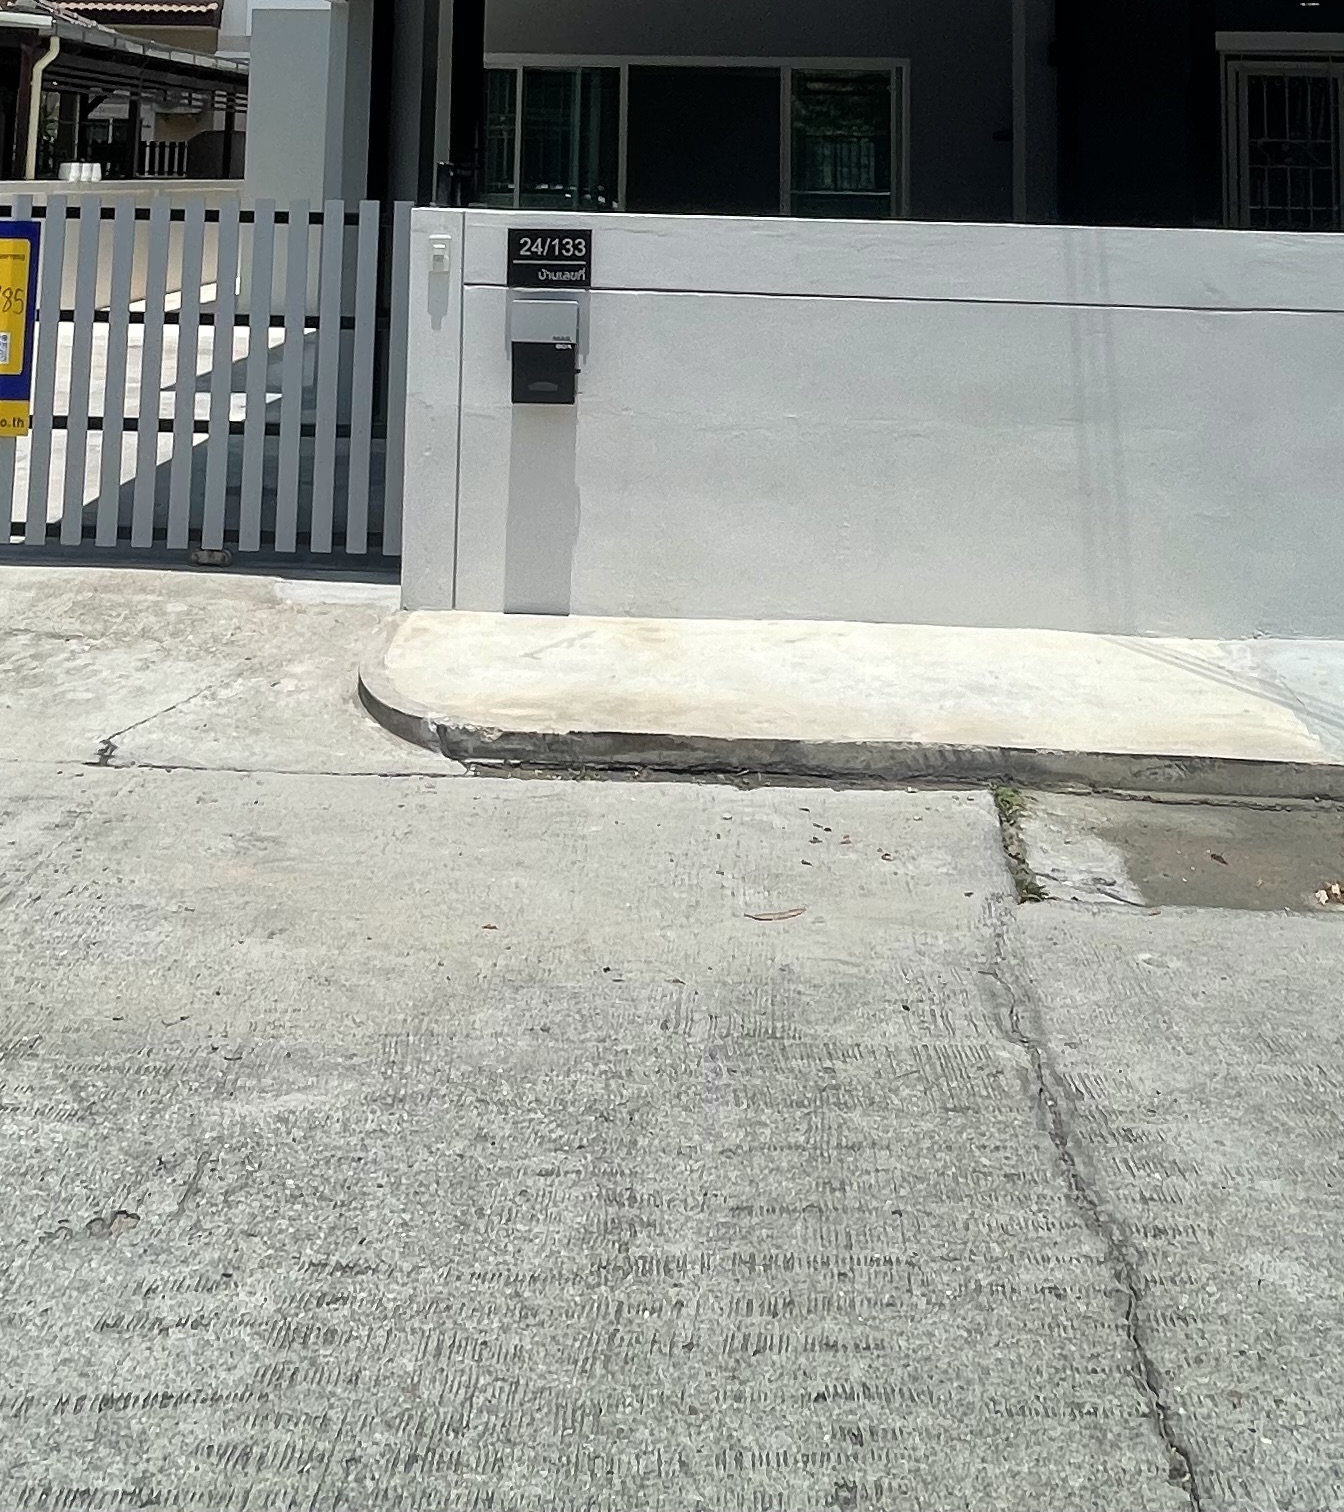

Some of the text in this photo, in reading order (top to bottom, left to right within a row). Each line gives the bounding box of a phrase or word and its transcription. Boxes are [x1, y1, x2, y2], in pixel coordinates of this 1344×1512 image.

[519, 237, 586, 256] 24/133
[538, 268, 586, 281] บ้านเลขที่
